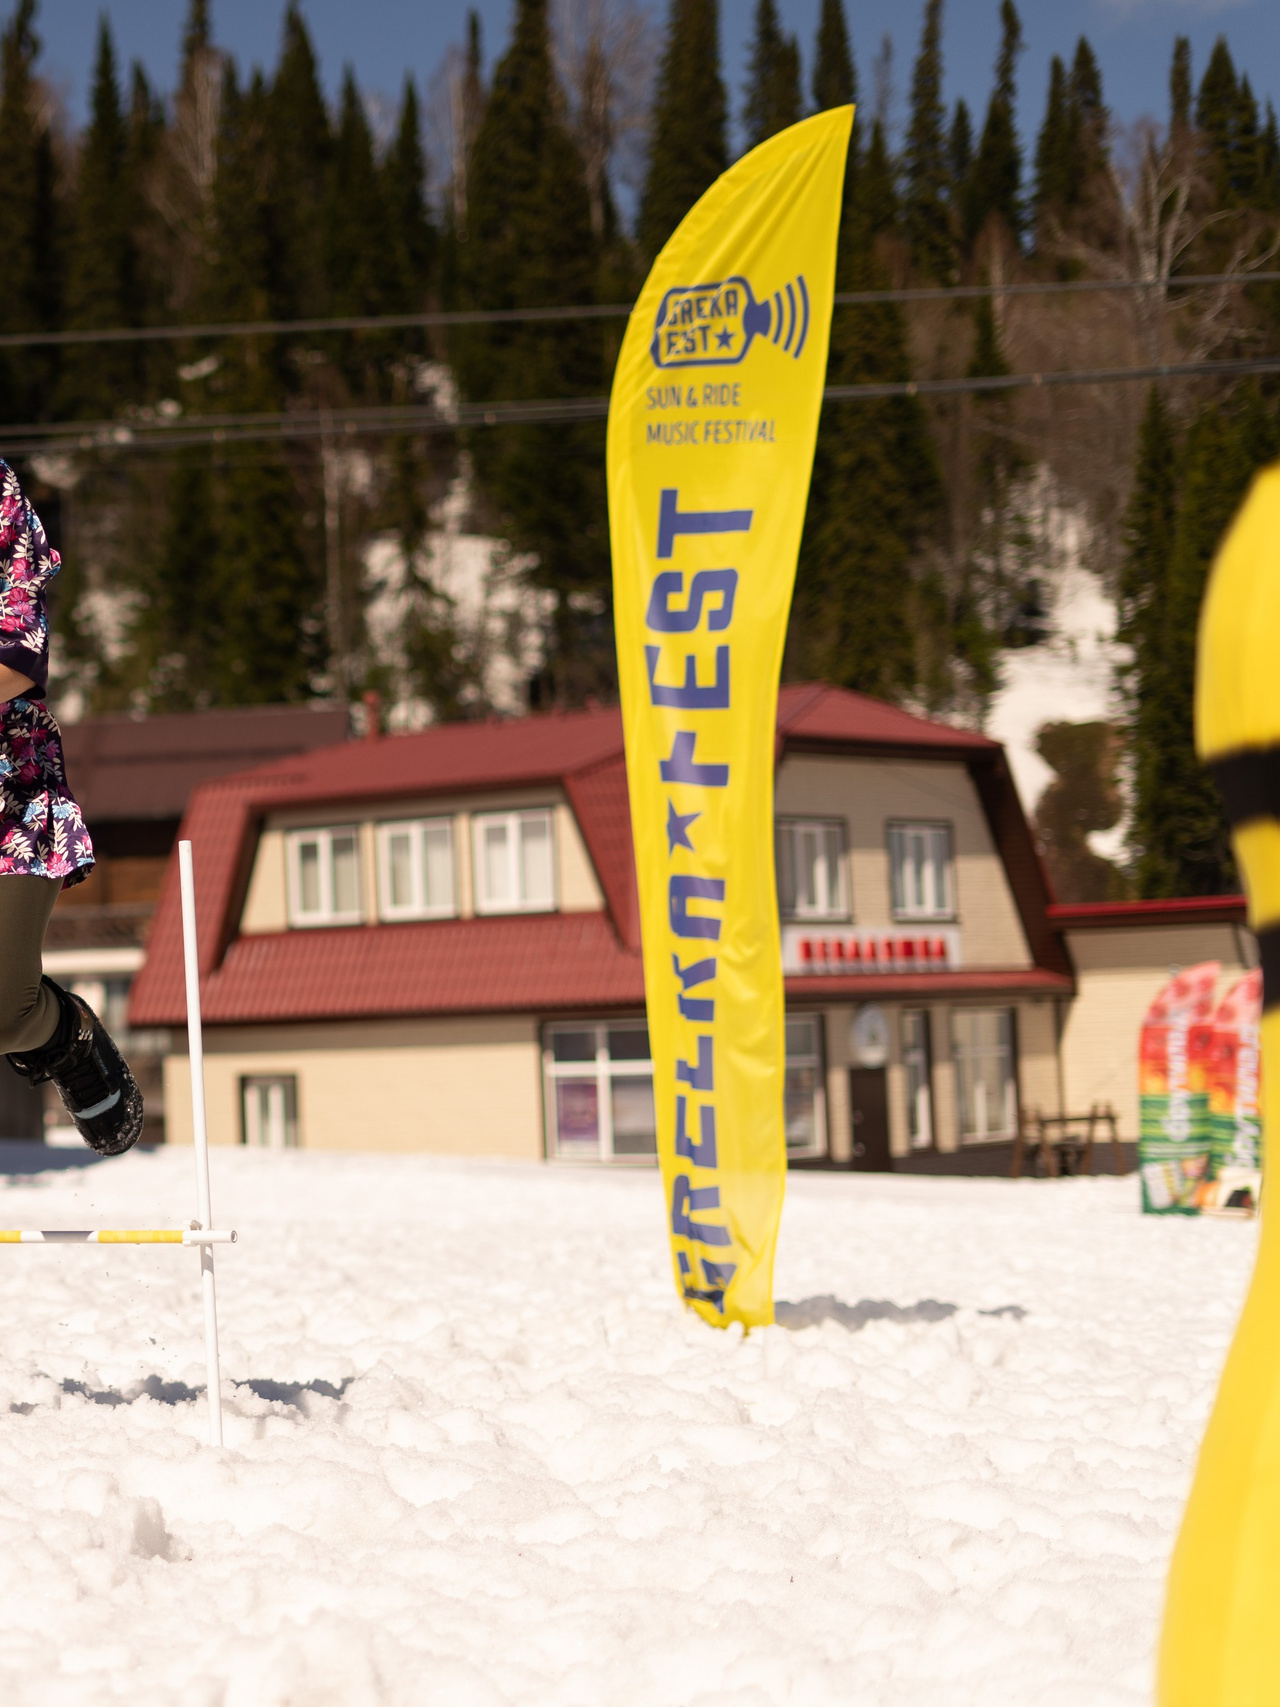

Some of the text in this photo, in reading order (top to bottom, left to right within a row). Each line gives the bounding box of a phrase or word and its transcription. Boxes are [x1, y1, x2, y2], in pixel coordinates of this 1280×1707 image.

[646, 382, 741, 410] SUN & RIDE
[646, 418, 777, 446] MUSIC FESTIVAL
